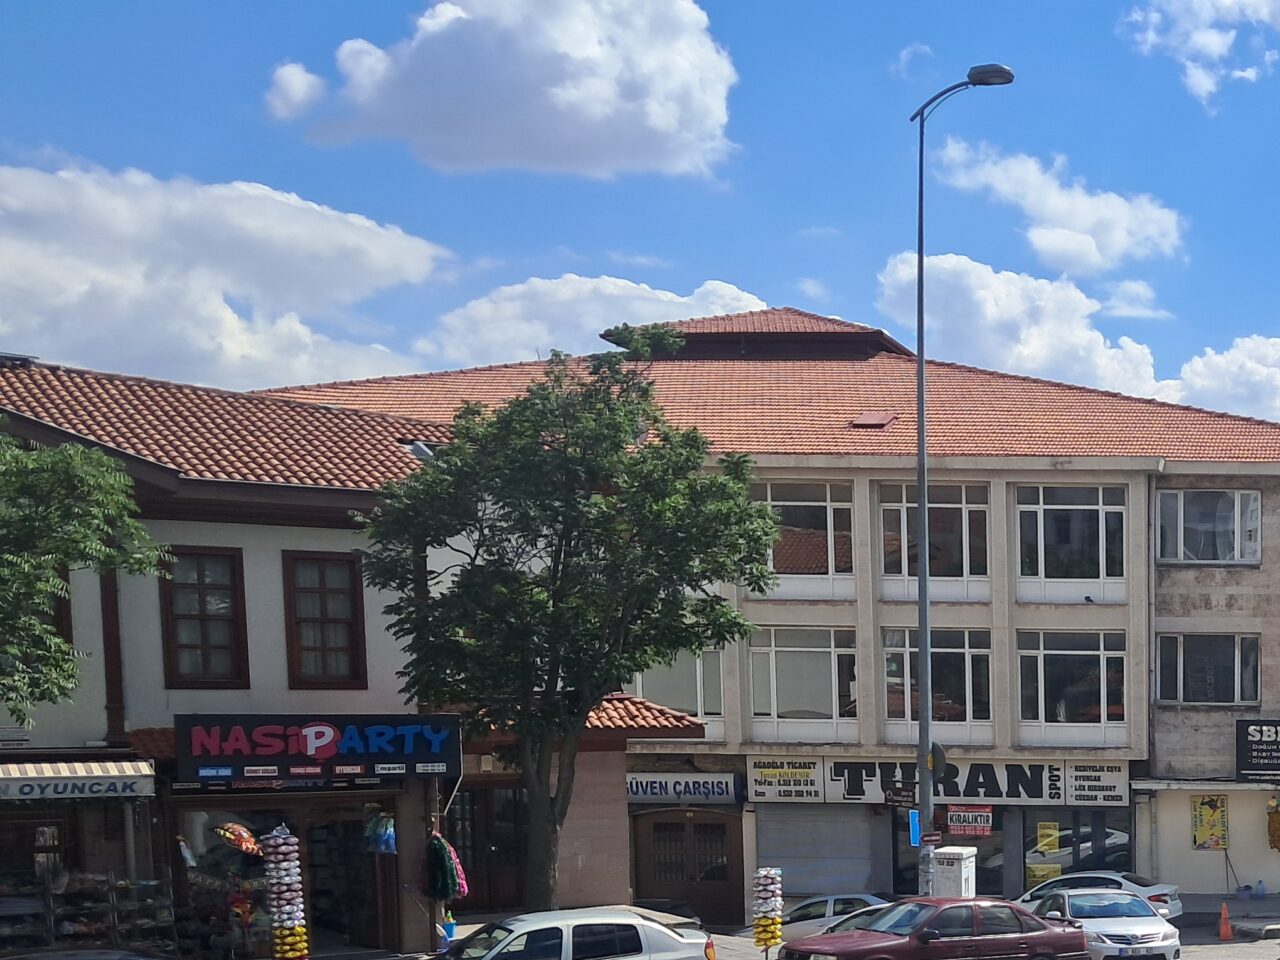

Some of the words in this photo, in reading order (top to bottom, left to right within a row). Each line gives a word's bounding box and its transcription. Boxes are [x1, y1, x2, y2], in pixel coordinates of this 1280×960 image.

[18, 781, 138, 796] OYUNCAK
[673, 780, 729, 799] ÇARŞISI
[1048, 765, 1061, 800] SPOT
